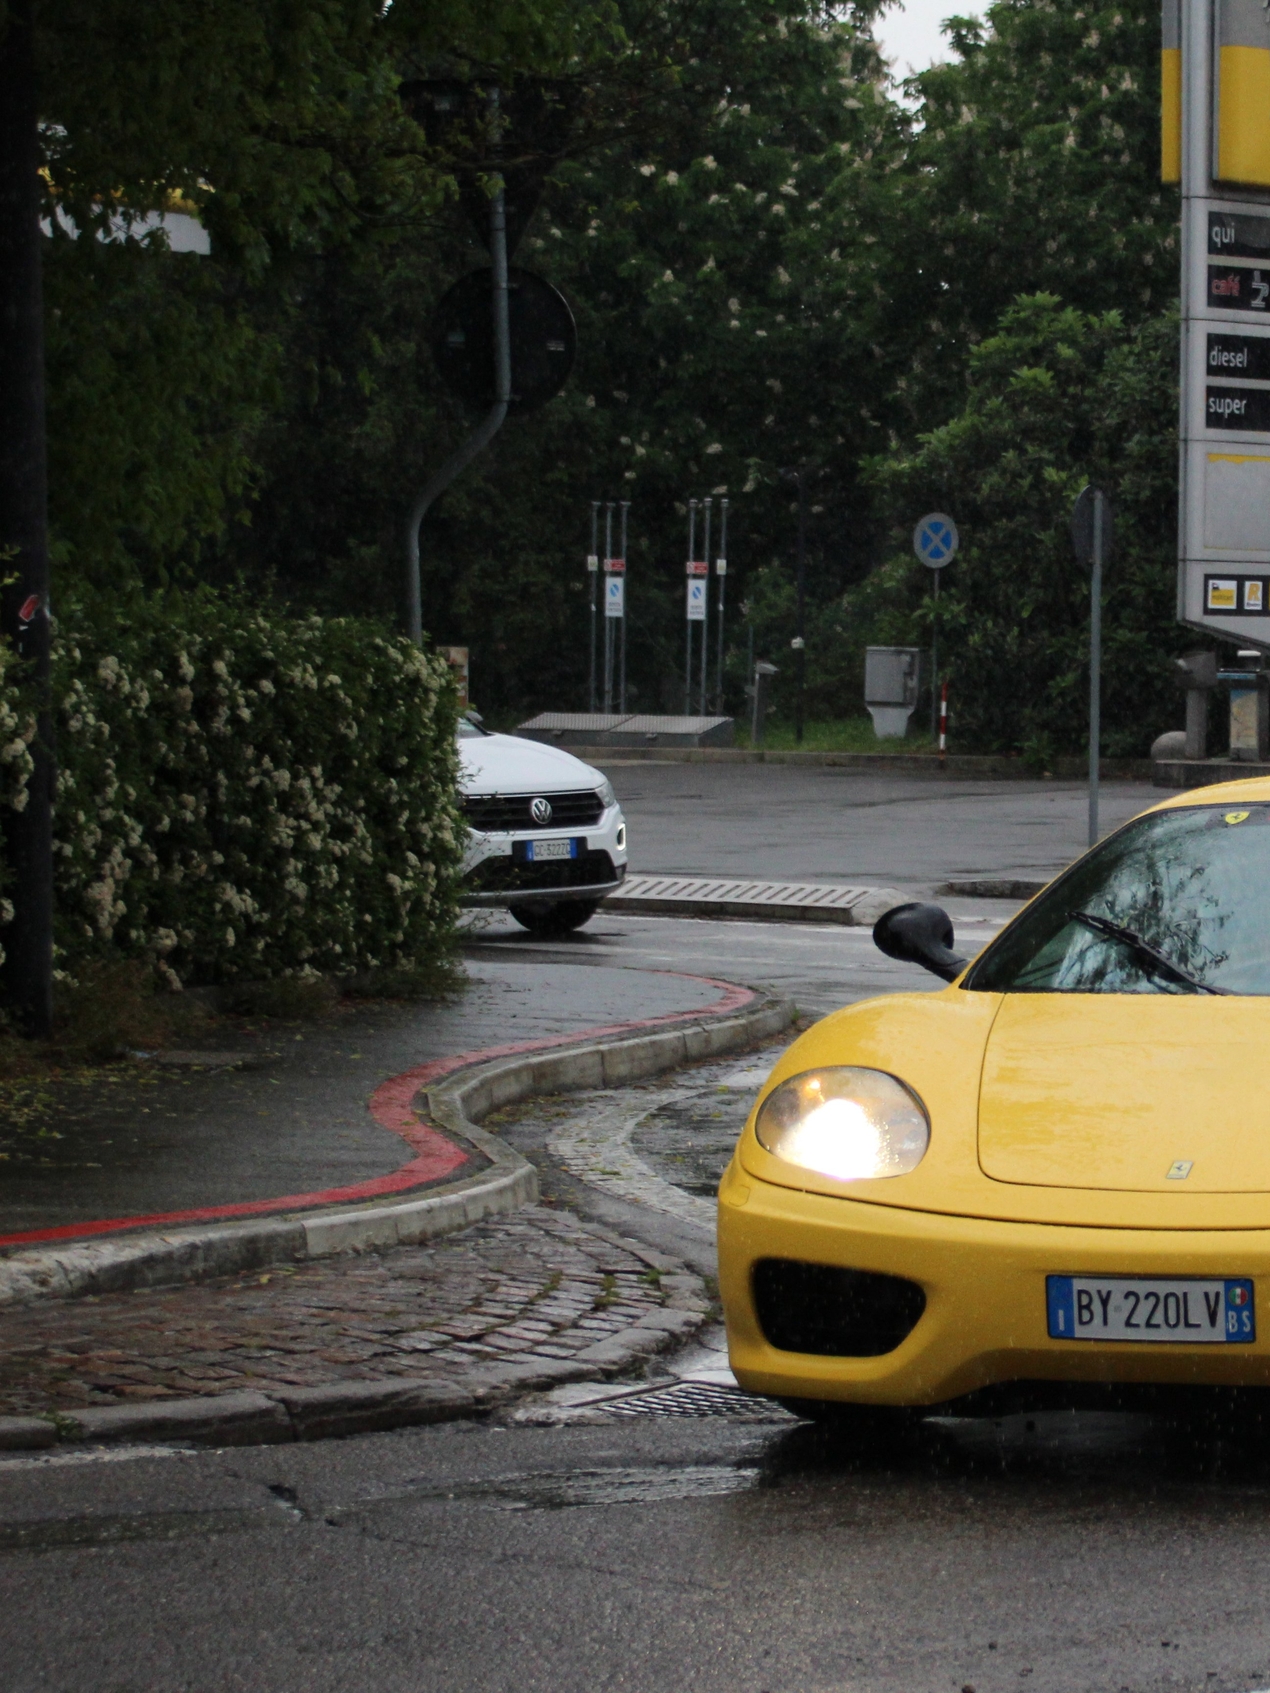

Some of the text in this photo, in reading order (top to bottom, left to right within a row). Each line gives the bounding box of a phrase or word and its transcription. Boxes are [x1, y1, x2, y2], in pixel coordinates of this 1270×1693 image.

[1212, 222, 1235, 247] qui
[1209, 346, 1248, 368] diesel
[1208, 397, 1247, 418] super
[1077, 1289, 1112, 1326] BY
[1123, 1290, 1221, 1328] 220LV
